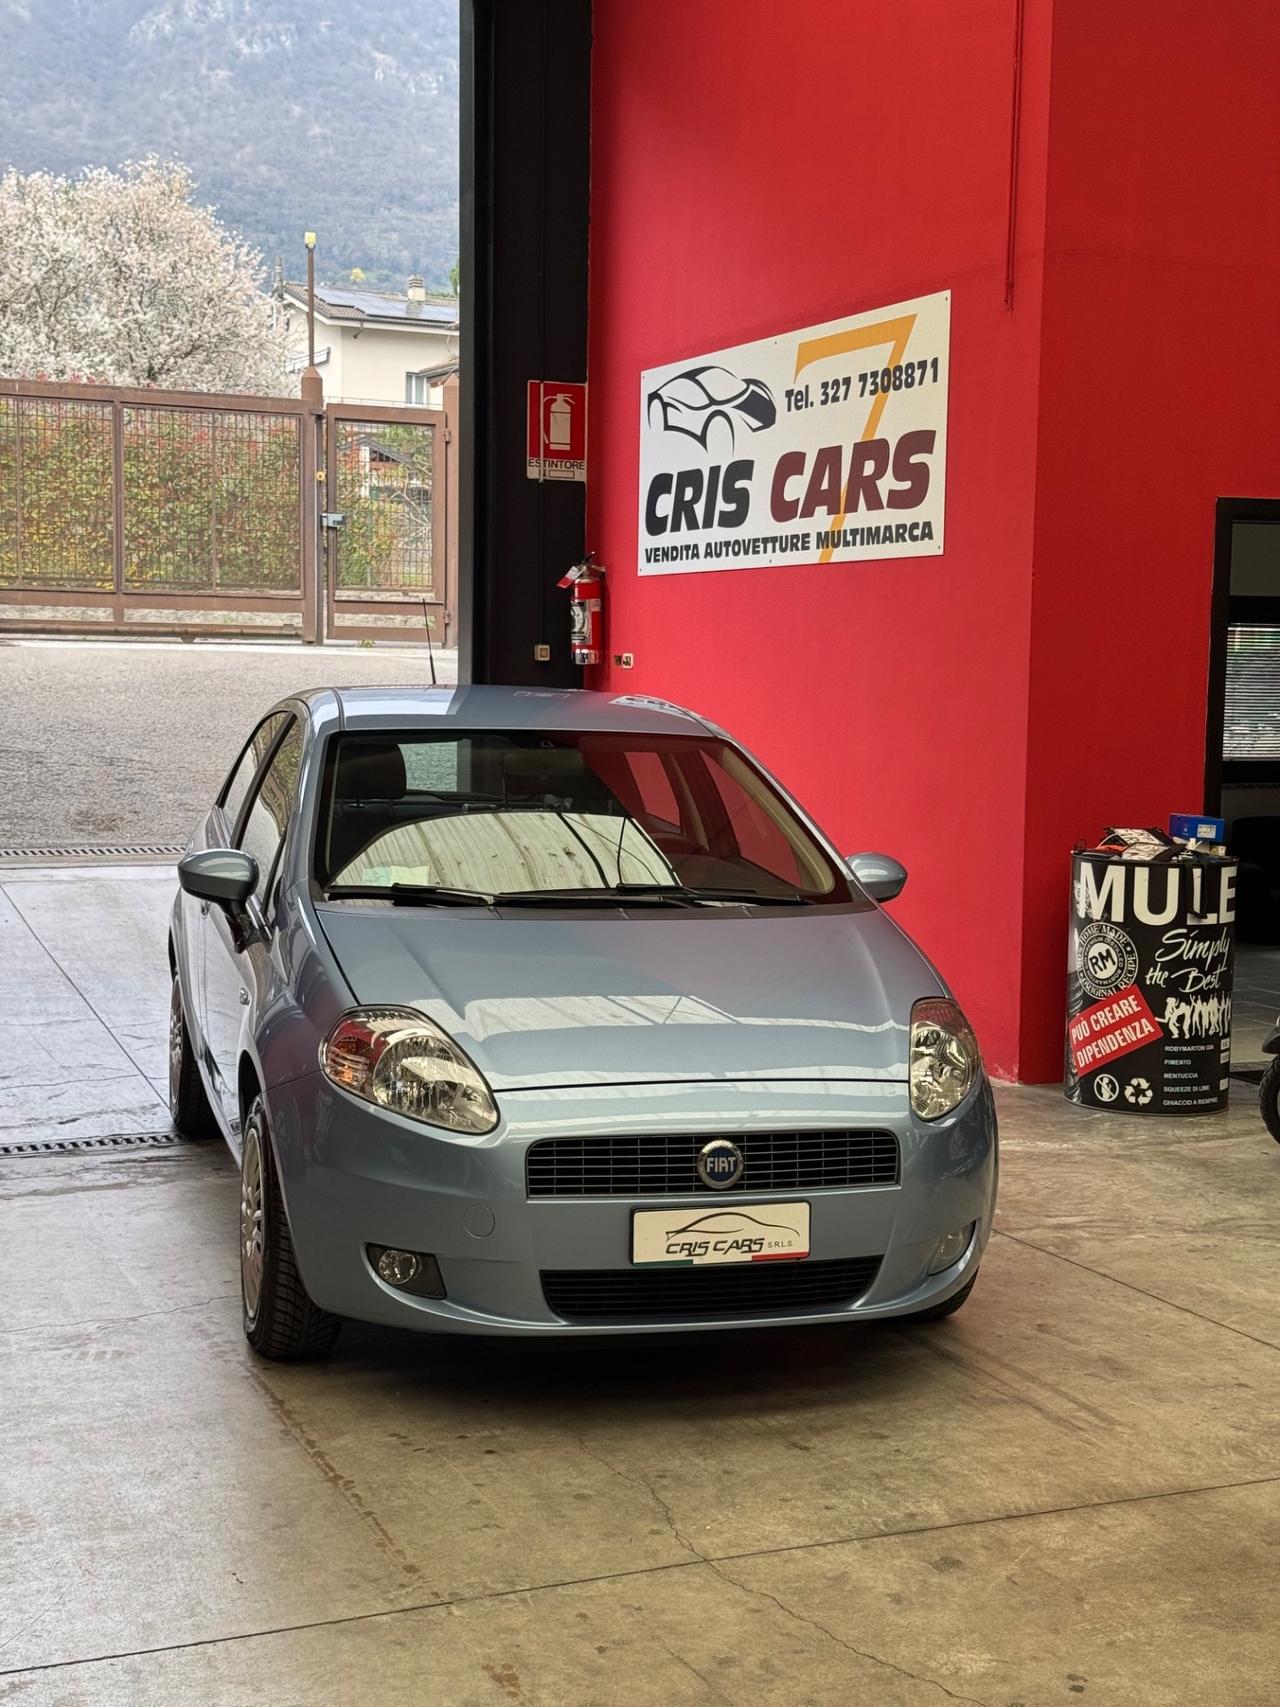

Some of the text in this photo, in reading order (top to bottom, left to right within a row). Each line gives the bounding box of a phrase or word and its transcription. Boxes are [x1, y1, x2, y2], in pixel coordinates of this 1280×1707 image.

[785, 357, 939, 412] Tel. 327 7308871
[528, 459, 585, 470] ESTINTORE
[645, 430, 936, 537] CRIS CARS
[645, 521, 934, 564] VENDITA AUTOVETTURE MULTIMARCA
[1080, 862, 1238, 926] MULE
[1102, 925, 1127, 947] MADE
[1155, 926, 1230, 971] Simply
[1089, 948, 1116, 974] RM
[1145, 962, 1227, 993] the Best
[1090, 995, 1142, 1031] CREARE
[1076, 1018, 1155, 1068] DIPENDENZA
[706, 1156, 736, 1173] FIAT
[665, 1241, 710, 1257] CRIS
[713, 1238, 765, 1255] CARS
